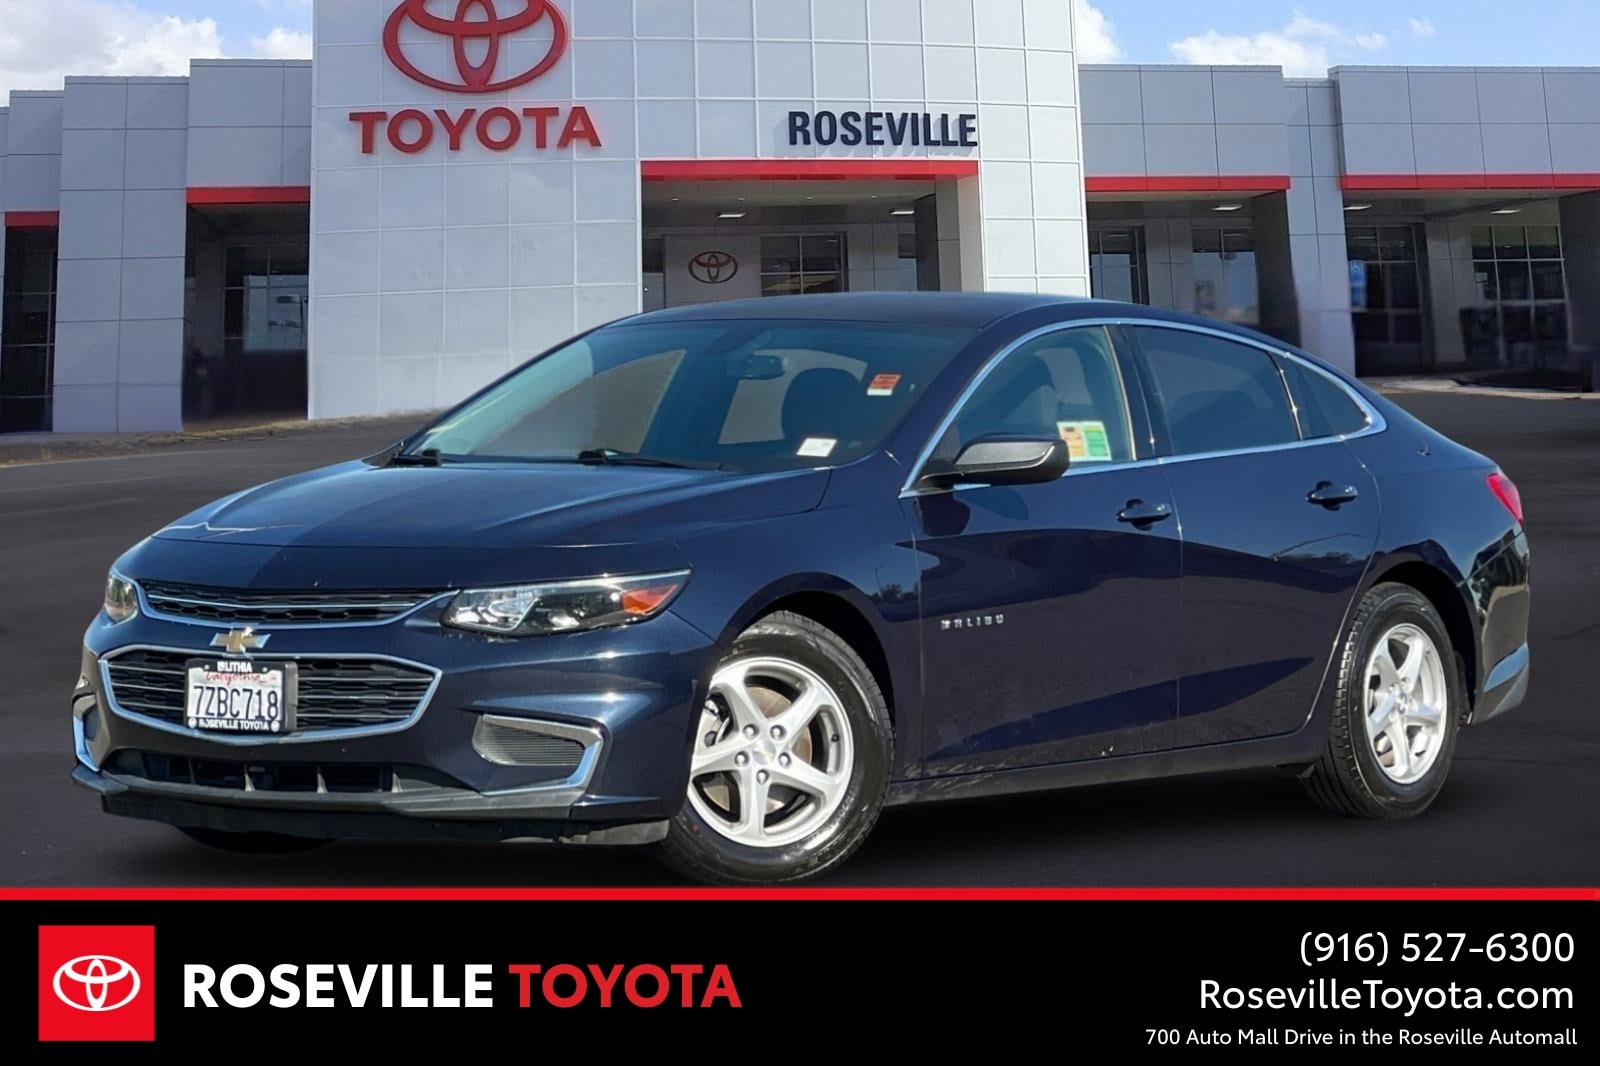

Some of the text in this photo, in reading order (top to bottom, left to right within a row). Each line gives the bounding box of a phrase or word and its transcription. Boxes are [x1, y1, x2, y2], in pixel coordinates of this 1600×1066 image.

[349, 106, 602, 154] TOYOTA
[788, 111, 978, 147] ROSEVILLE
[941, 614, 1004, 630] MALIBU
[225, 661, 253, 673] LITHIA
[193, 685, 279, 721] 7ZBC718
[199, 718, 269, 731] ROSEVILLE TOYOTA
